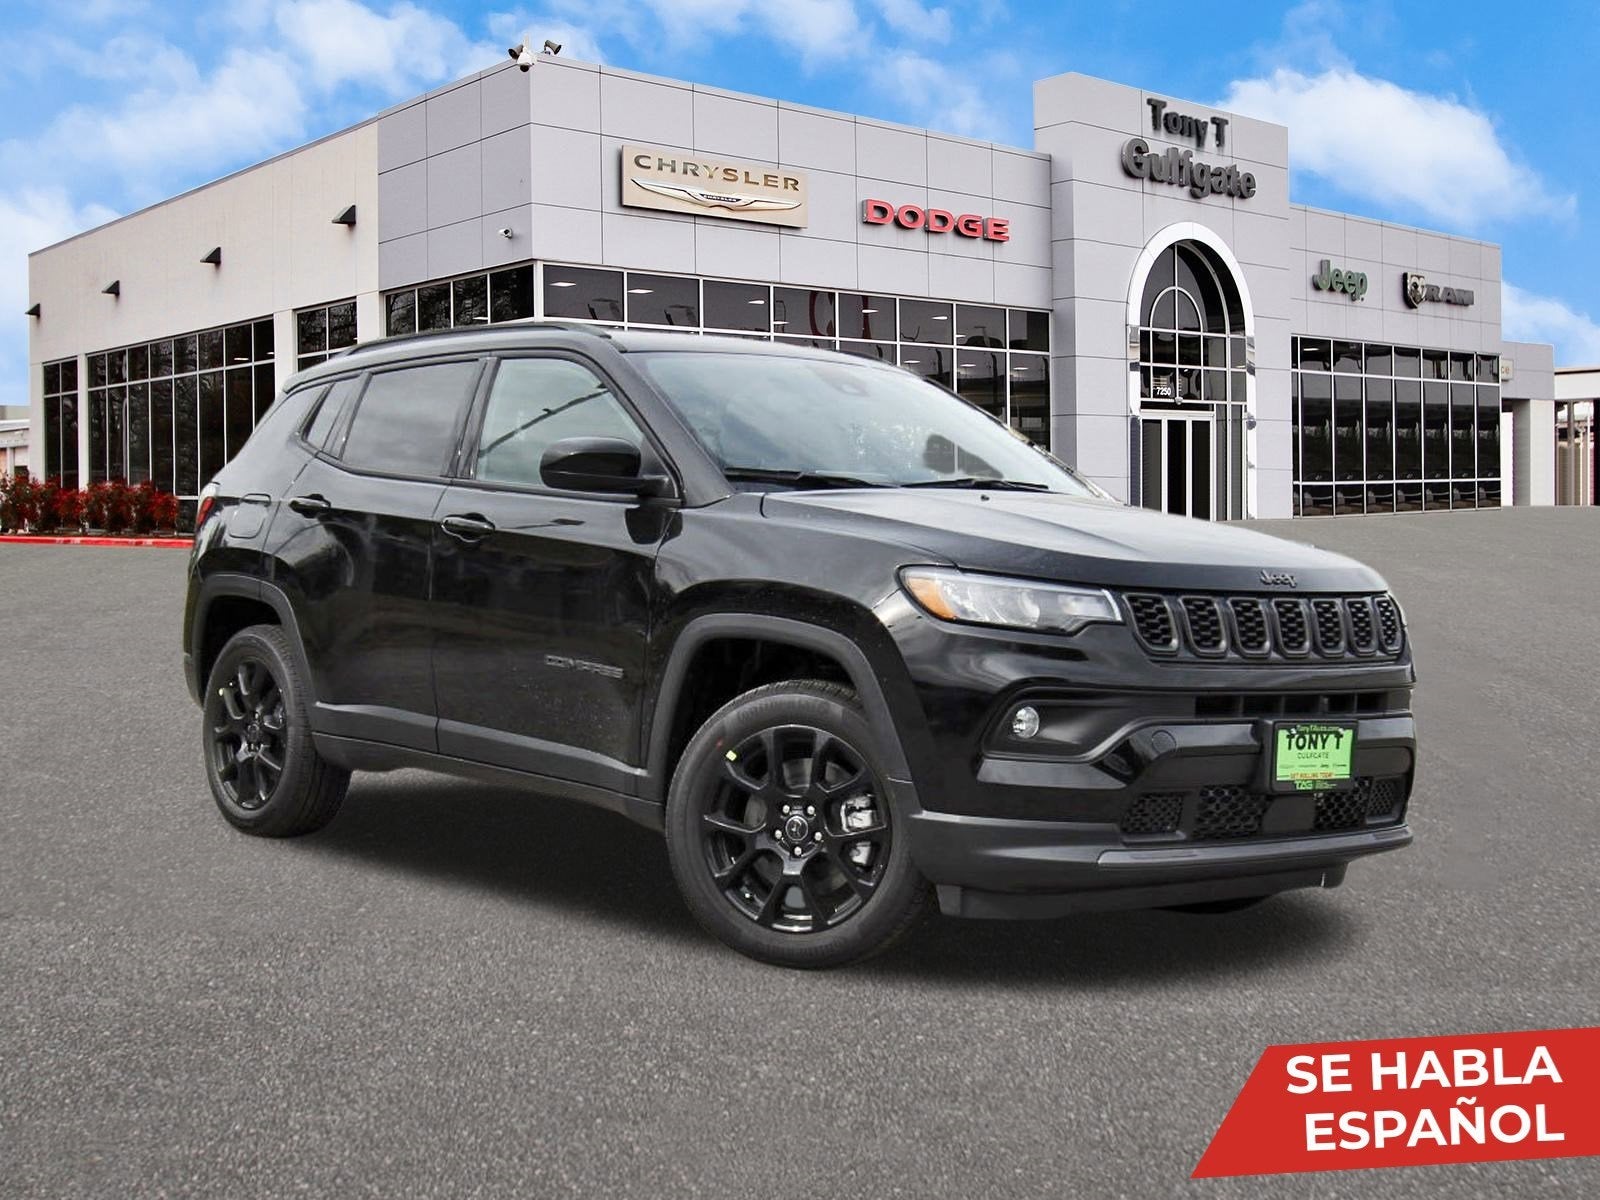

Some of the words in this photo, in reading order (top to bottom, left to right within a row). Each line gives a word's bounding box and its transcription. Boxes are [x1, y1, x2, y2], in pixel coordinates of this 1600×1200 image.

[1146, 98, 1209, 147] Tony
[1210, 116, 1229, 147] T
[633, 154, 800, 192] CHRYSLER
[1121, 138, 1257, 199] Gulfgate
[862, 198, 1010, 242] DODGE
[1312, 259, 1368, 302] Jeep
[1425, 283, 1475, 307] RAM
[1156, 386, 1172, 396] 7250
[1260, 569, 1298, 589] Jeep
[1286, 733, 1330, 751] TONY
[1334, 732, 1344, 750] T
